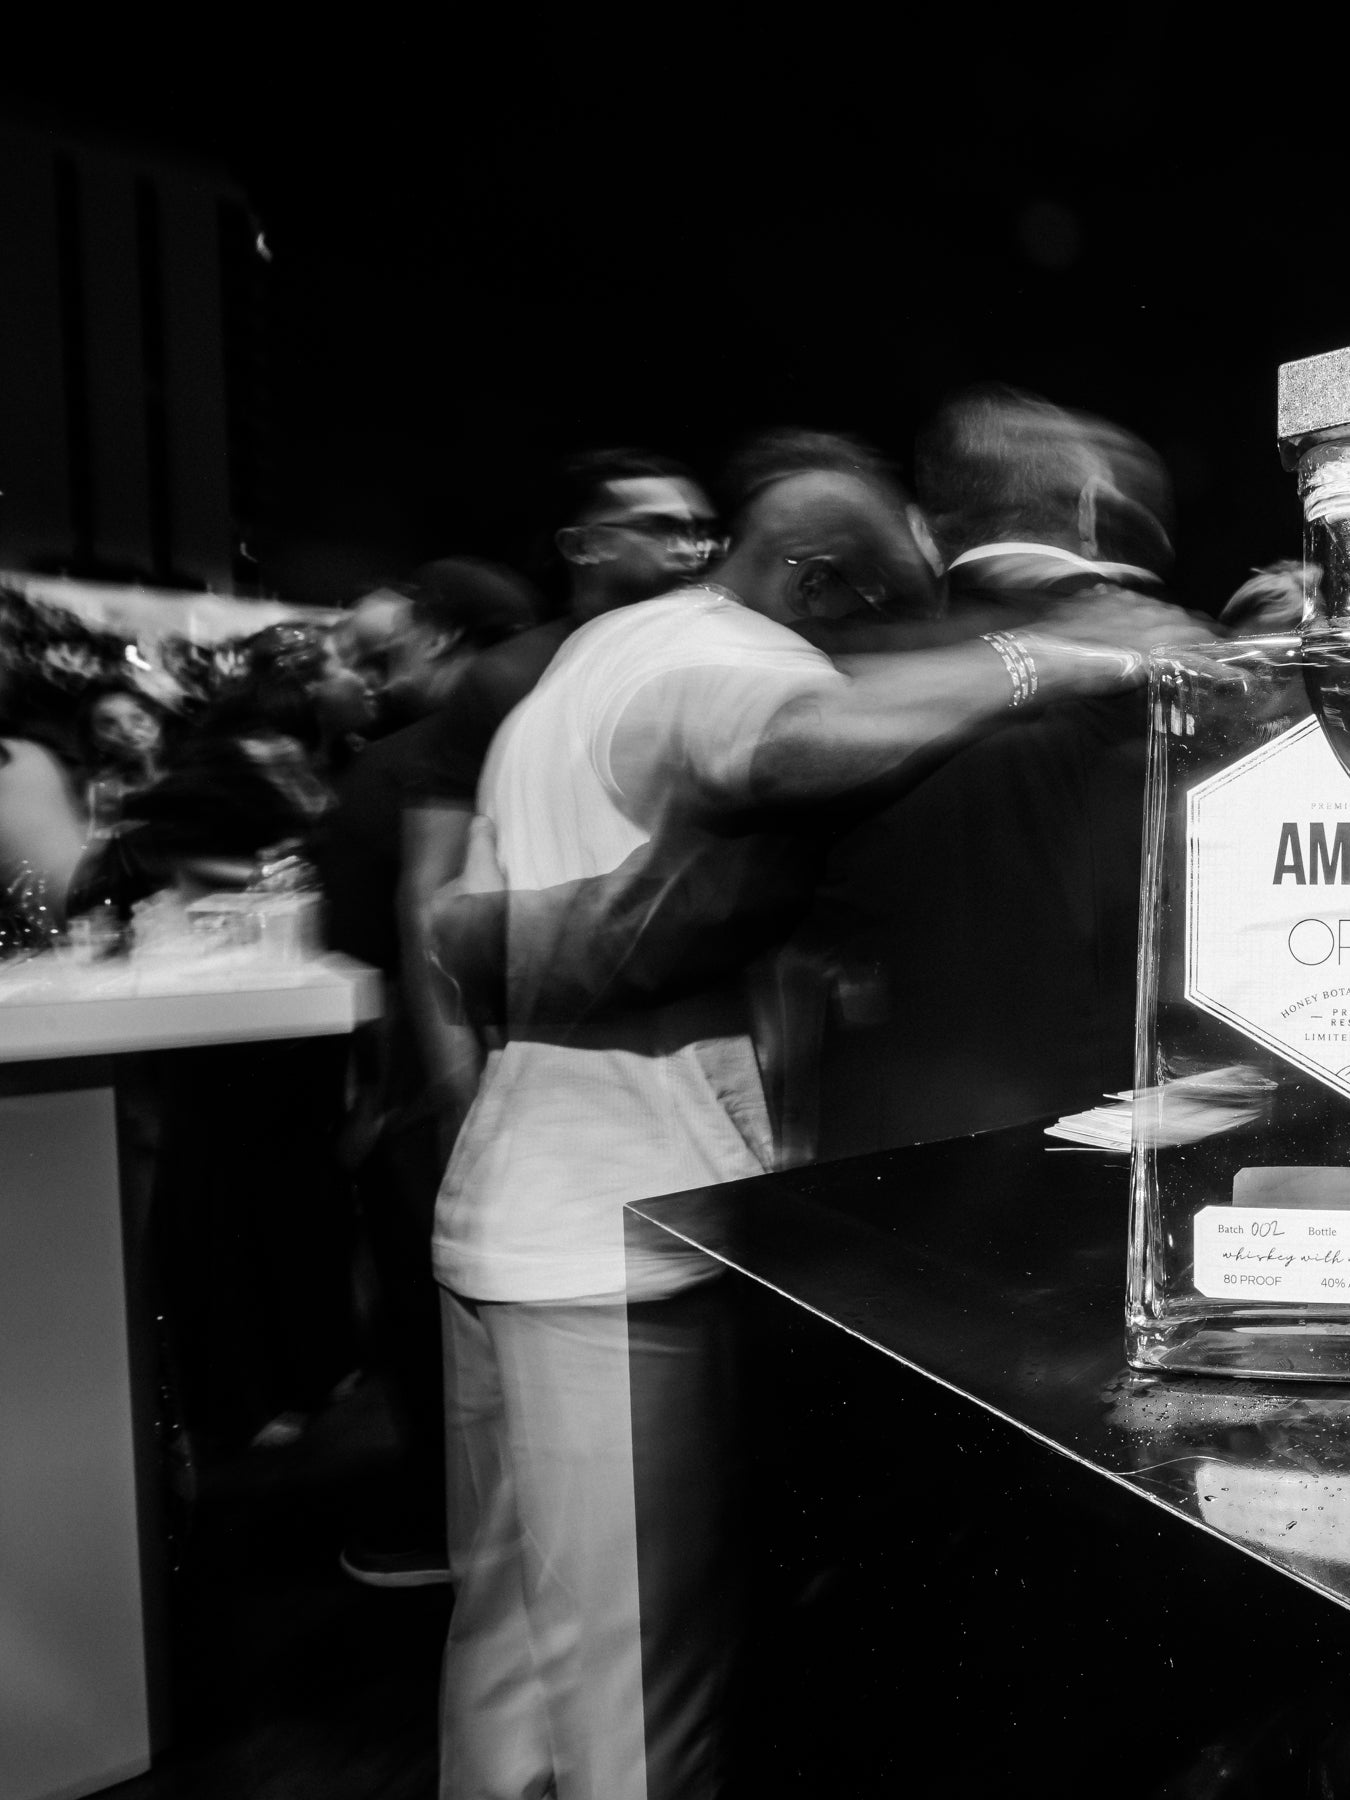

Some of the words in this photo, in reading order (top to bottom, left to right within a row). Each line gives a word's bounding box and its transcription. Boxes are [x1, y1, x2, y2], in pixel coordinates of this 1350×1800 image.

[1280, 994, 1319, 1019] HONEY
[1217, 1224, 1244, 1235] Batch
[1308, 1226, 1338, 1238] Bottle
[1222, 1247, 1295, 1267] whiskey
[1300, 1248, 1344, 1264] with
[1223, 1274, 1238, 1285] 80
[1240, 1275, 1283, 1287] PROOF
[1320, 1278, 1346, 1289] 40%
